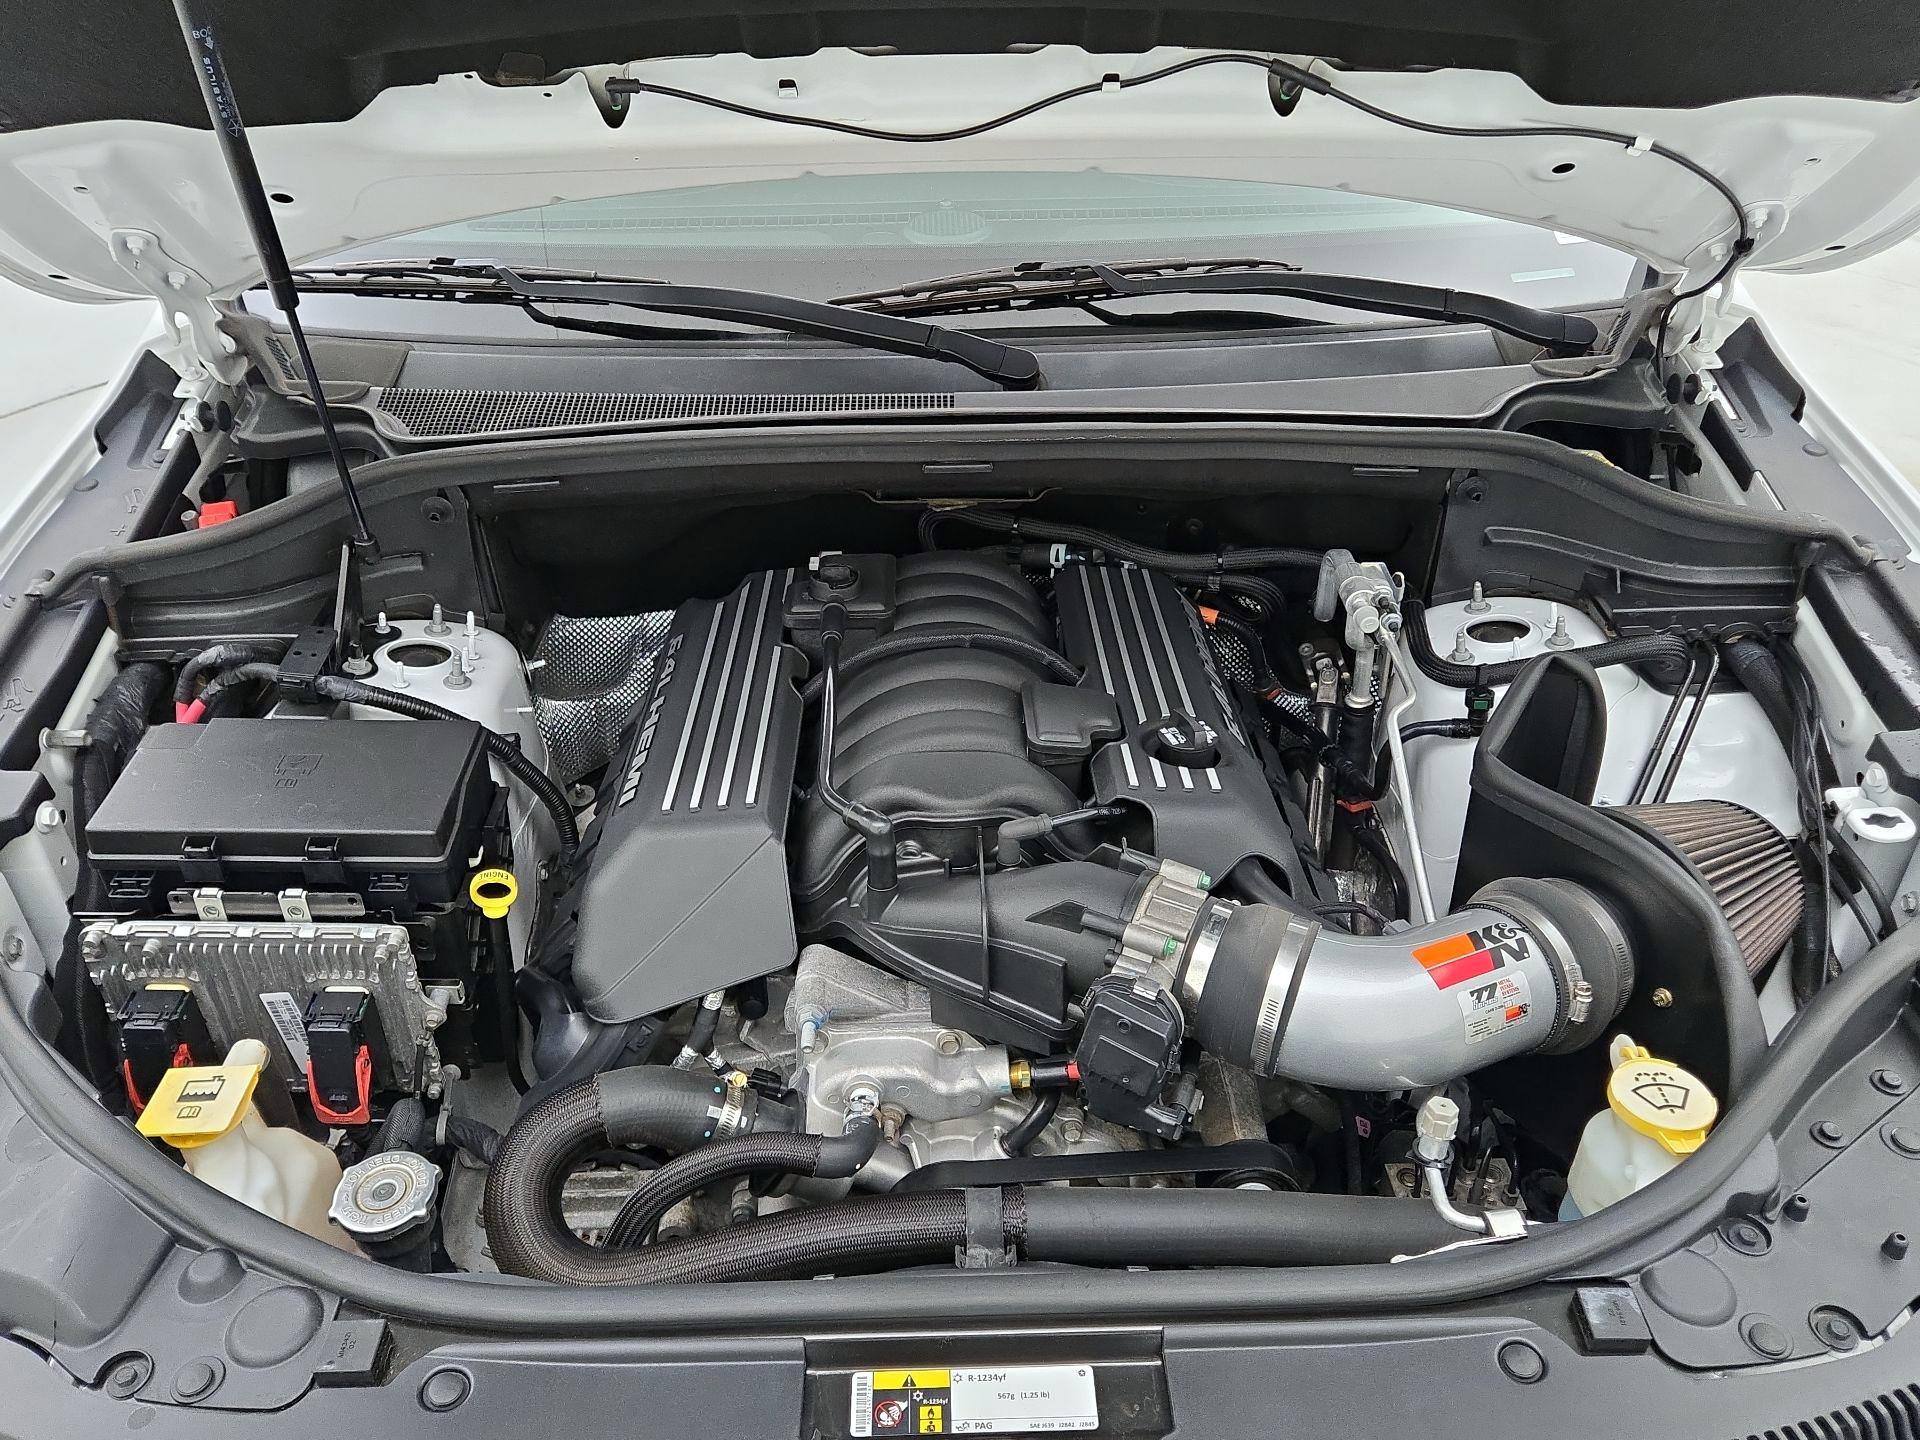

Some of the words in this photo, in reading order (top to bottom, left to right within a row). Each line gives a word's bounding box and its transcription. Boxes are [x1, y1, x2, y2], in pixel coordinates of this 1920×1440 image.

[203, 56, 229, 119] STABILUS
[618, 696, 666, 807] HEMI
[479, 871, 509, 881] ENGINE
[1467, 922, 1530, 969] K&N
[1469, 982, 1498, 1003] 77
[367, 1155, 401, 1170] OPEN
[345, 1168, 366, 1188] HOT
[375, 1203, 413, 1225] KEEP
[968, 1373, 1006, 1383] R-1234yf
[997, 1391, 1015, 1401] 567g
[1020, 1391, 1039, 1400] (1.25
[1040, 1391, 1050, 1399] lb)
[974, 1421, 993, 1430] PAG
